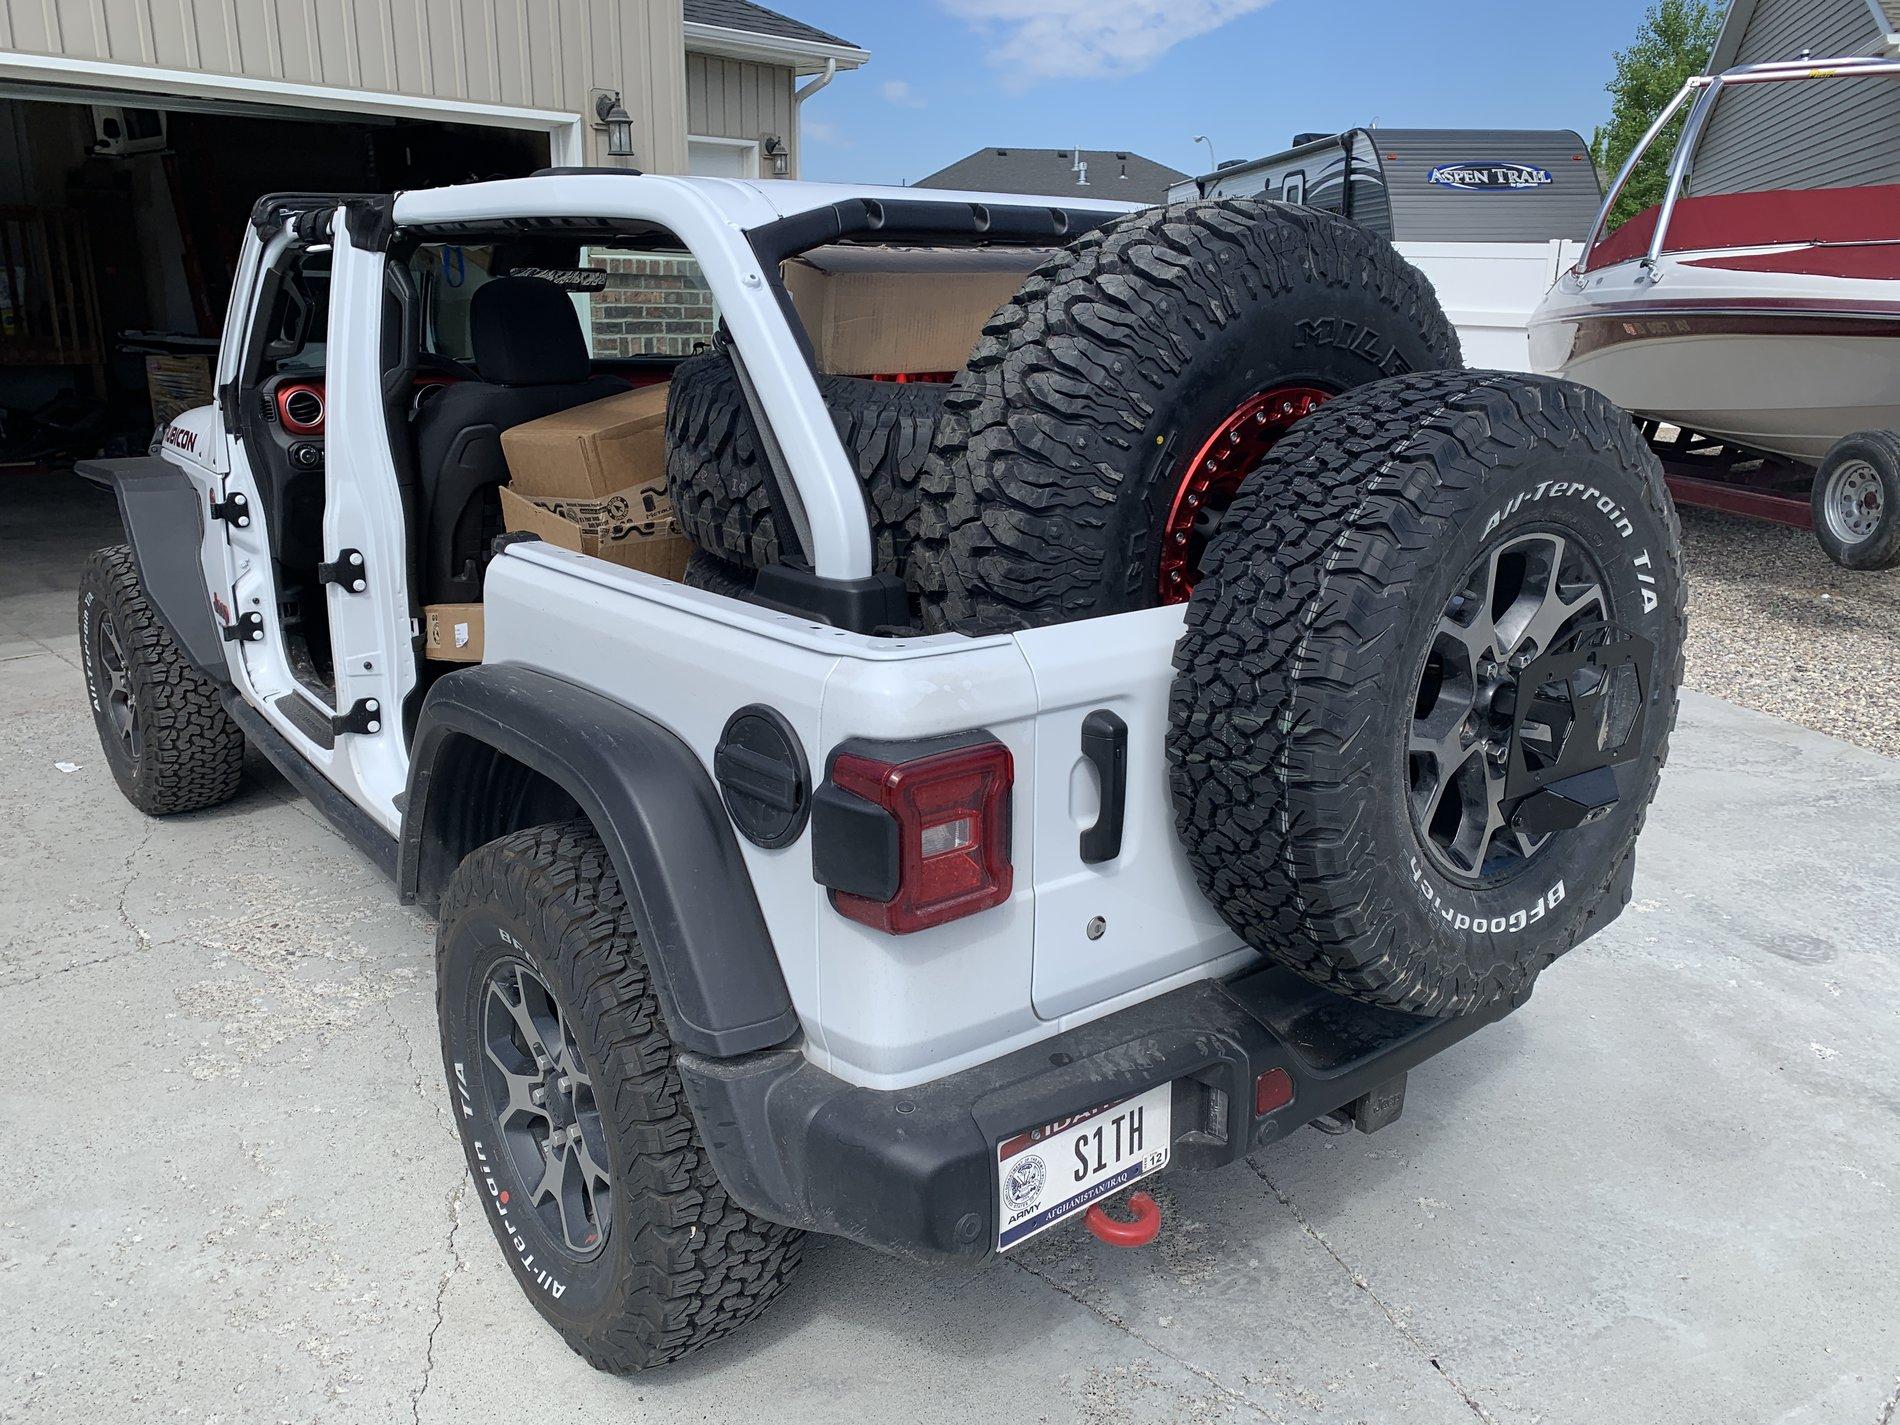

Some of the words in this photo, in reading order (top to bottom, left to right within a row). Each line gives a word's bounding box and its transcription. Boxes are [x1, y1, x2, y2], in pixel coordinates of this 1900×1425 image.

[1429, 168, 1489, 183] ASPEN
[1491, 168, 1551, 183] TRAIL
[1480, 480, 1634, 542] All-Terrain
[1631, 549, 1658, 615] T/A
[1409, 856, 1566, 933] BFGoodrich
[453, 1062, 473, 1119] T/A
[1073, 1105, 1143, 1182] S1TH
[1150, 1152, 1162, 1165] 12
[474, 1141, 566, 1300] All-Terrain
[1008, 1201, 1041, 1225] ARMY
[1045, 1172, 1128, 1221] AFGHANISTAN/IRAQ
